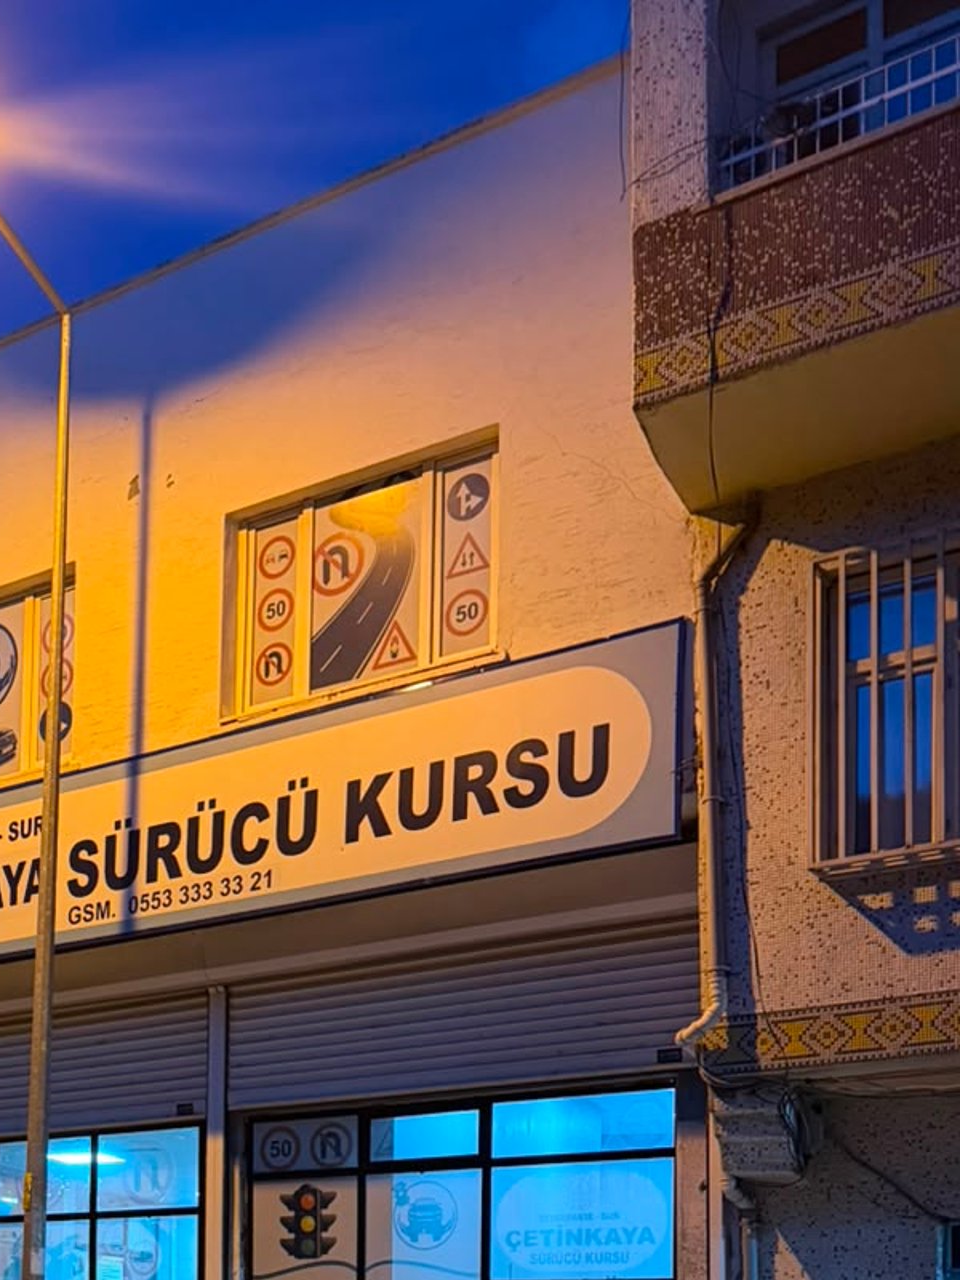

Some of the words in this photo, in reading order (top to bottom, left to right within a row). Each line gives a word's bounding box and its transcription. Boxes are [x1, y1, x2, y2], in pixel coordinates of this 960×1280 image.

[266, 600, 286, 619] 50
[455, 602, 478, 622] 50
[66, 776, 319, 898] SÜRÜCÜ
[344, 723, 611, 844] KURSU
[8, 815, 43, 842] SUR
[67, 900, 116, 925] GSM.
[128, 888, 172, 915] 0553
[179, 880, 213, 905] 333
[220, 874, 243, 897] 33
[250, 869, 273, 892] 21
[270, 1139, 292, 1158] 50
[505, 1224, 656, 1252] ÇETİNKAYA
